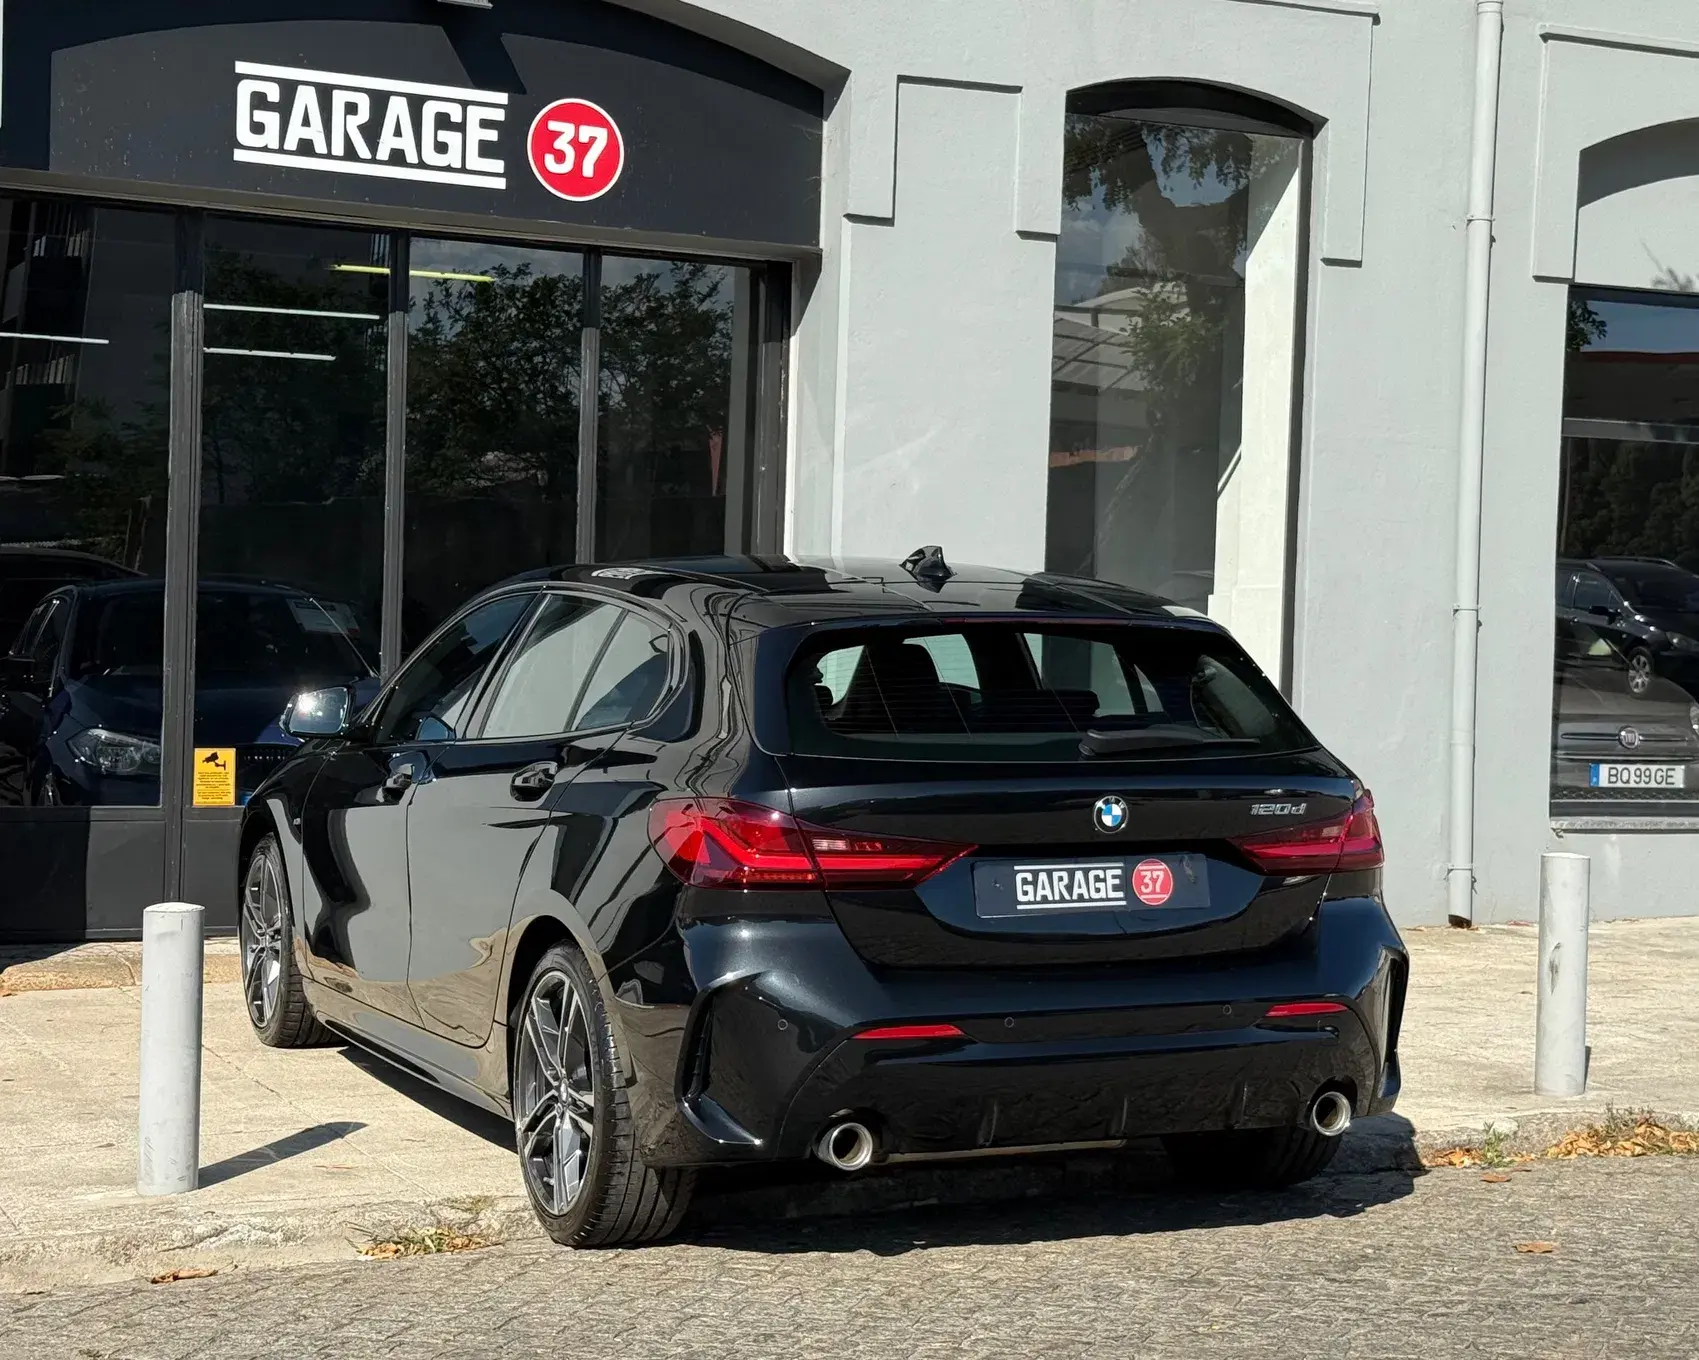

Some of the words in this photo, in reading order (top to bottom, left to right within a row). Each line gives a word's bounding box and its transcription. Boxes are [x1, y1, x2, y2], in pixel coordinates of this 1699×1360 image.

[235, 78, 506, 174] GARAGE
[543, 119, 609, 179] 37
[1251, 802, 1307, 815] 120d
[1015, 868, 1125, 902] GARAGE
[1140, 870, 1165, 894] 37
